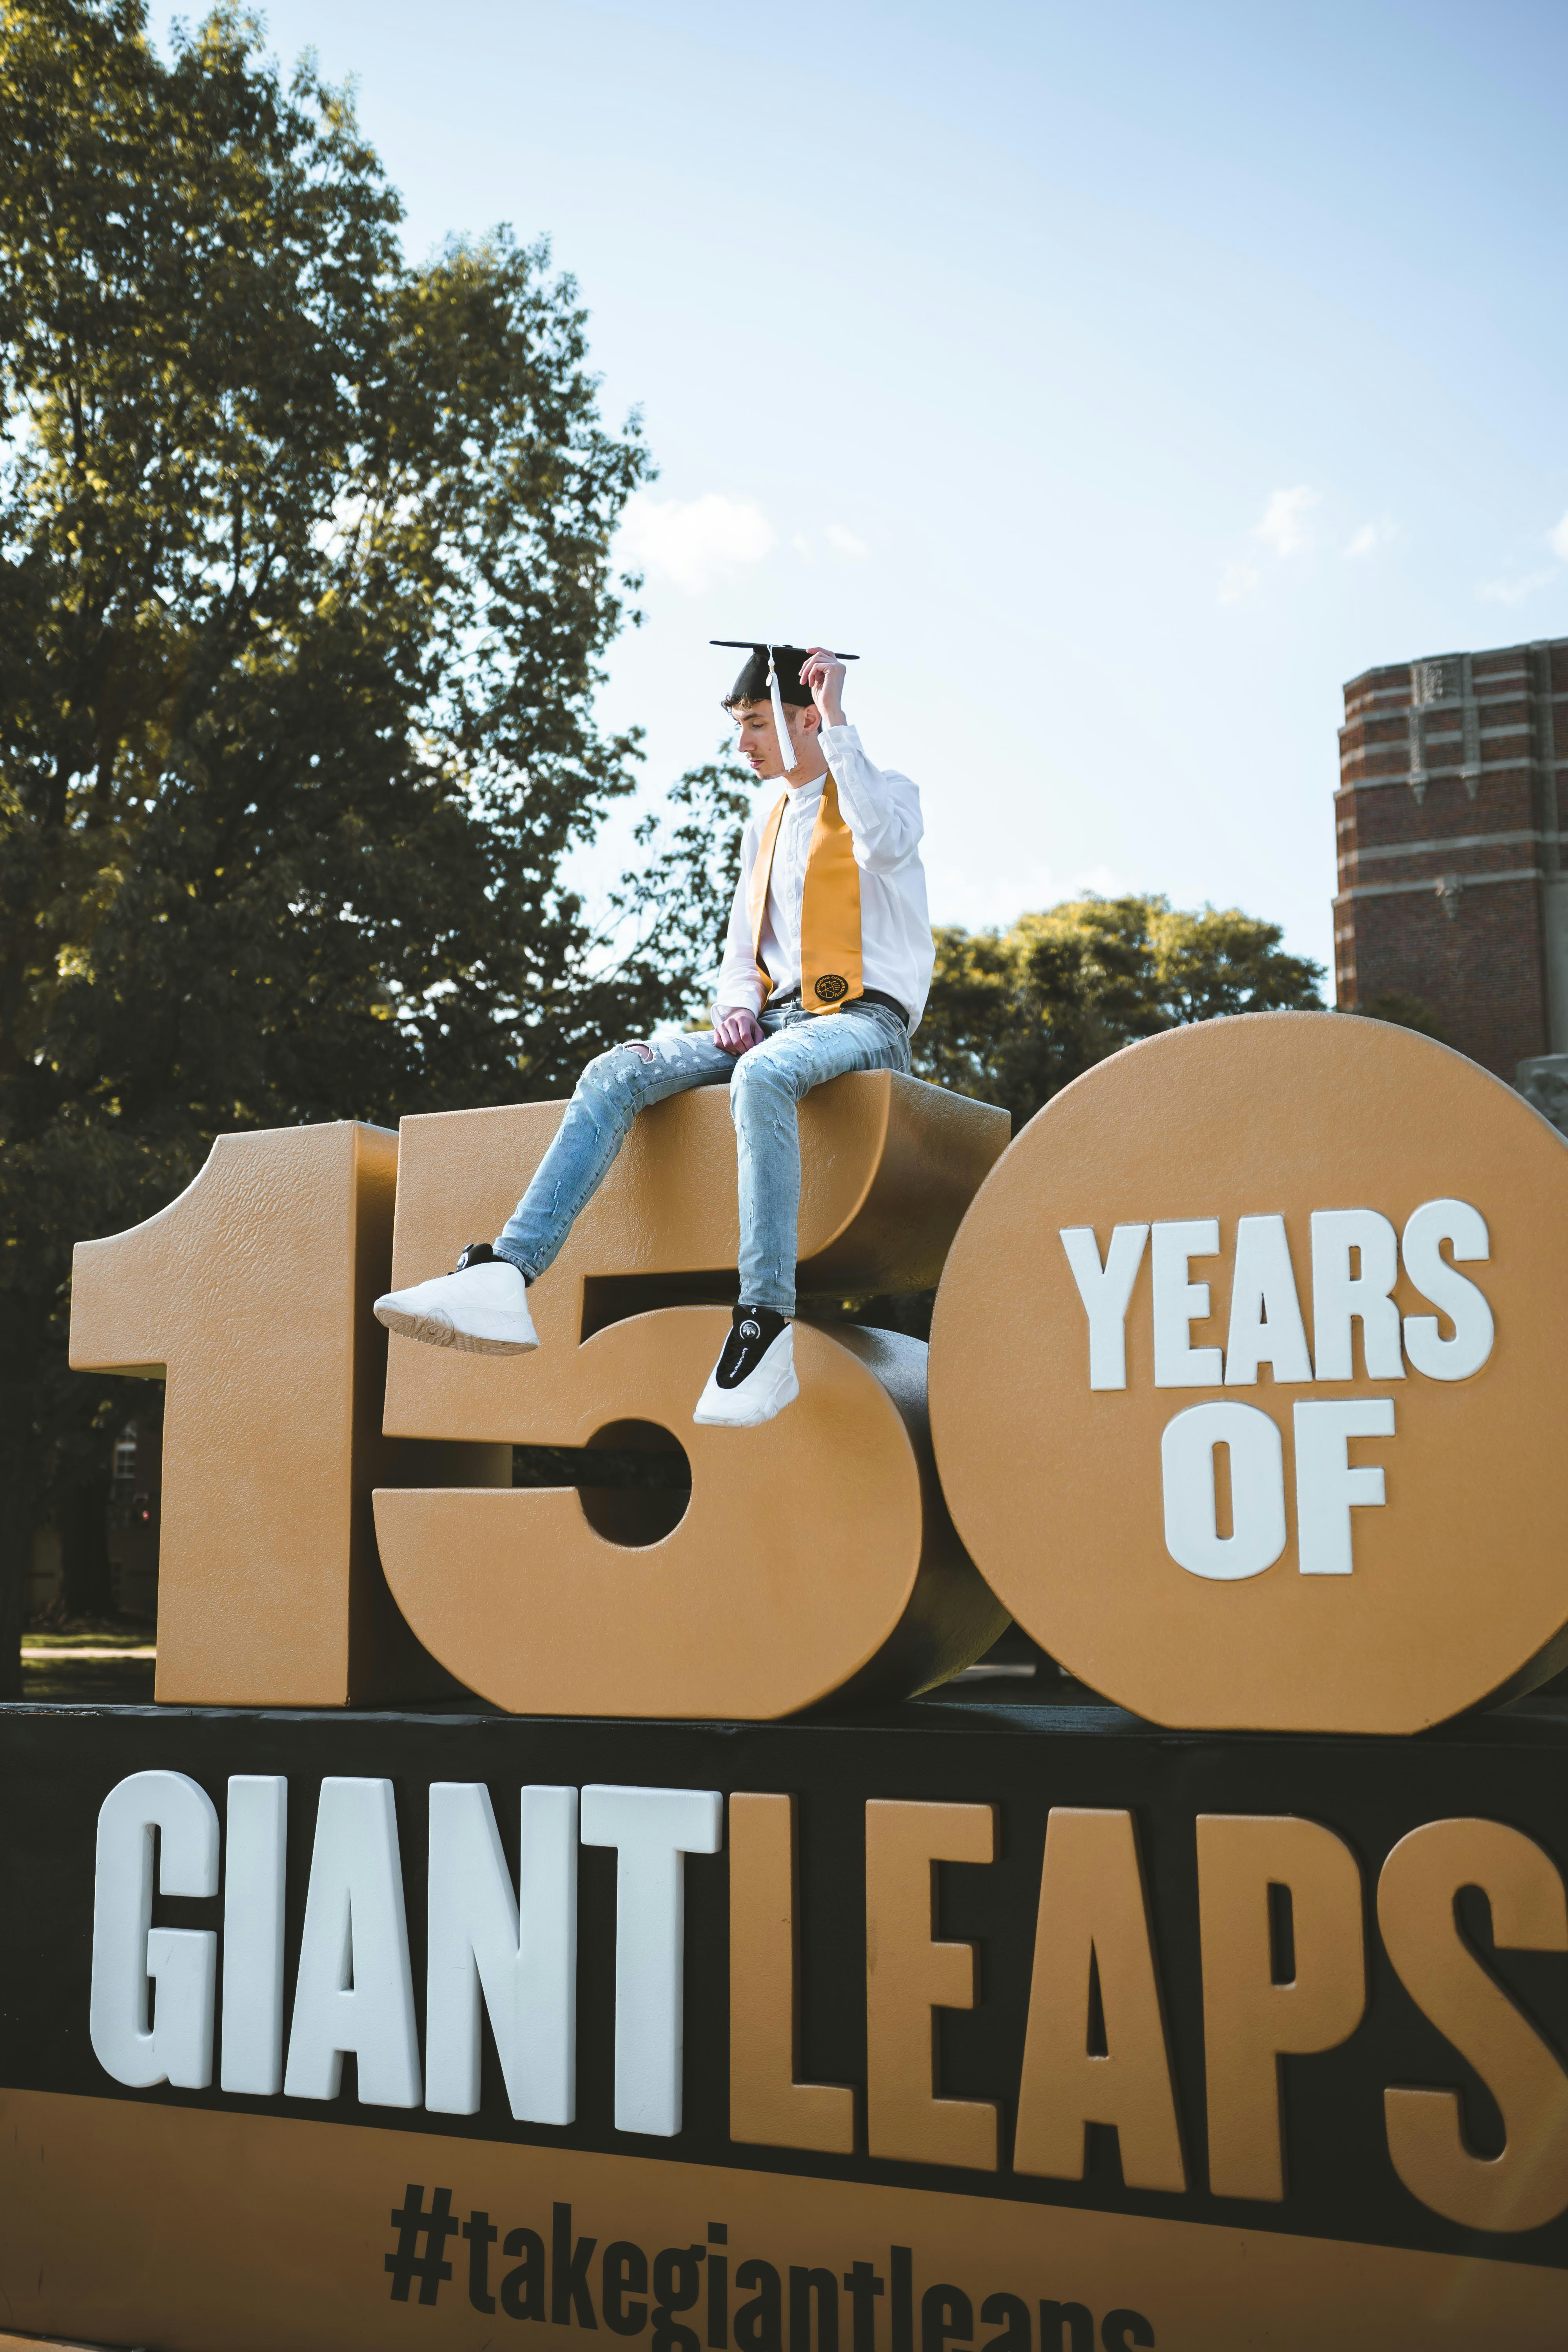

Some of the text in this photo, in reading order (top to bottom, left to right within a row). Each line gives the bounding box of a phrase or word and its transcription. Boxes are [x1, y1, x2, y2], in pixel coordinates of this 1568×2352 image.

[70, 1011, 1568, 1734] 150
[1058, 1198, 1494, 1391] YEARS
[1161, 1398, 1396, 1581] OF
